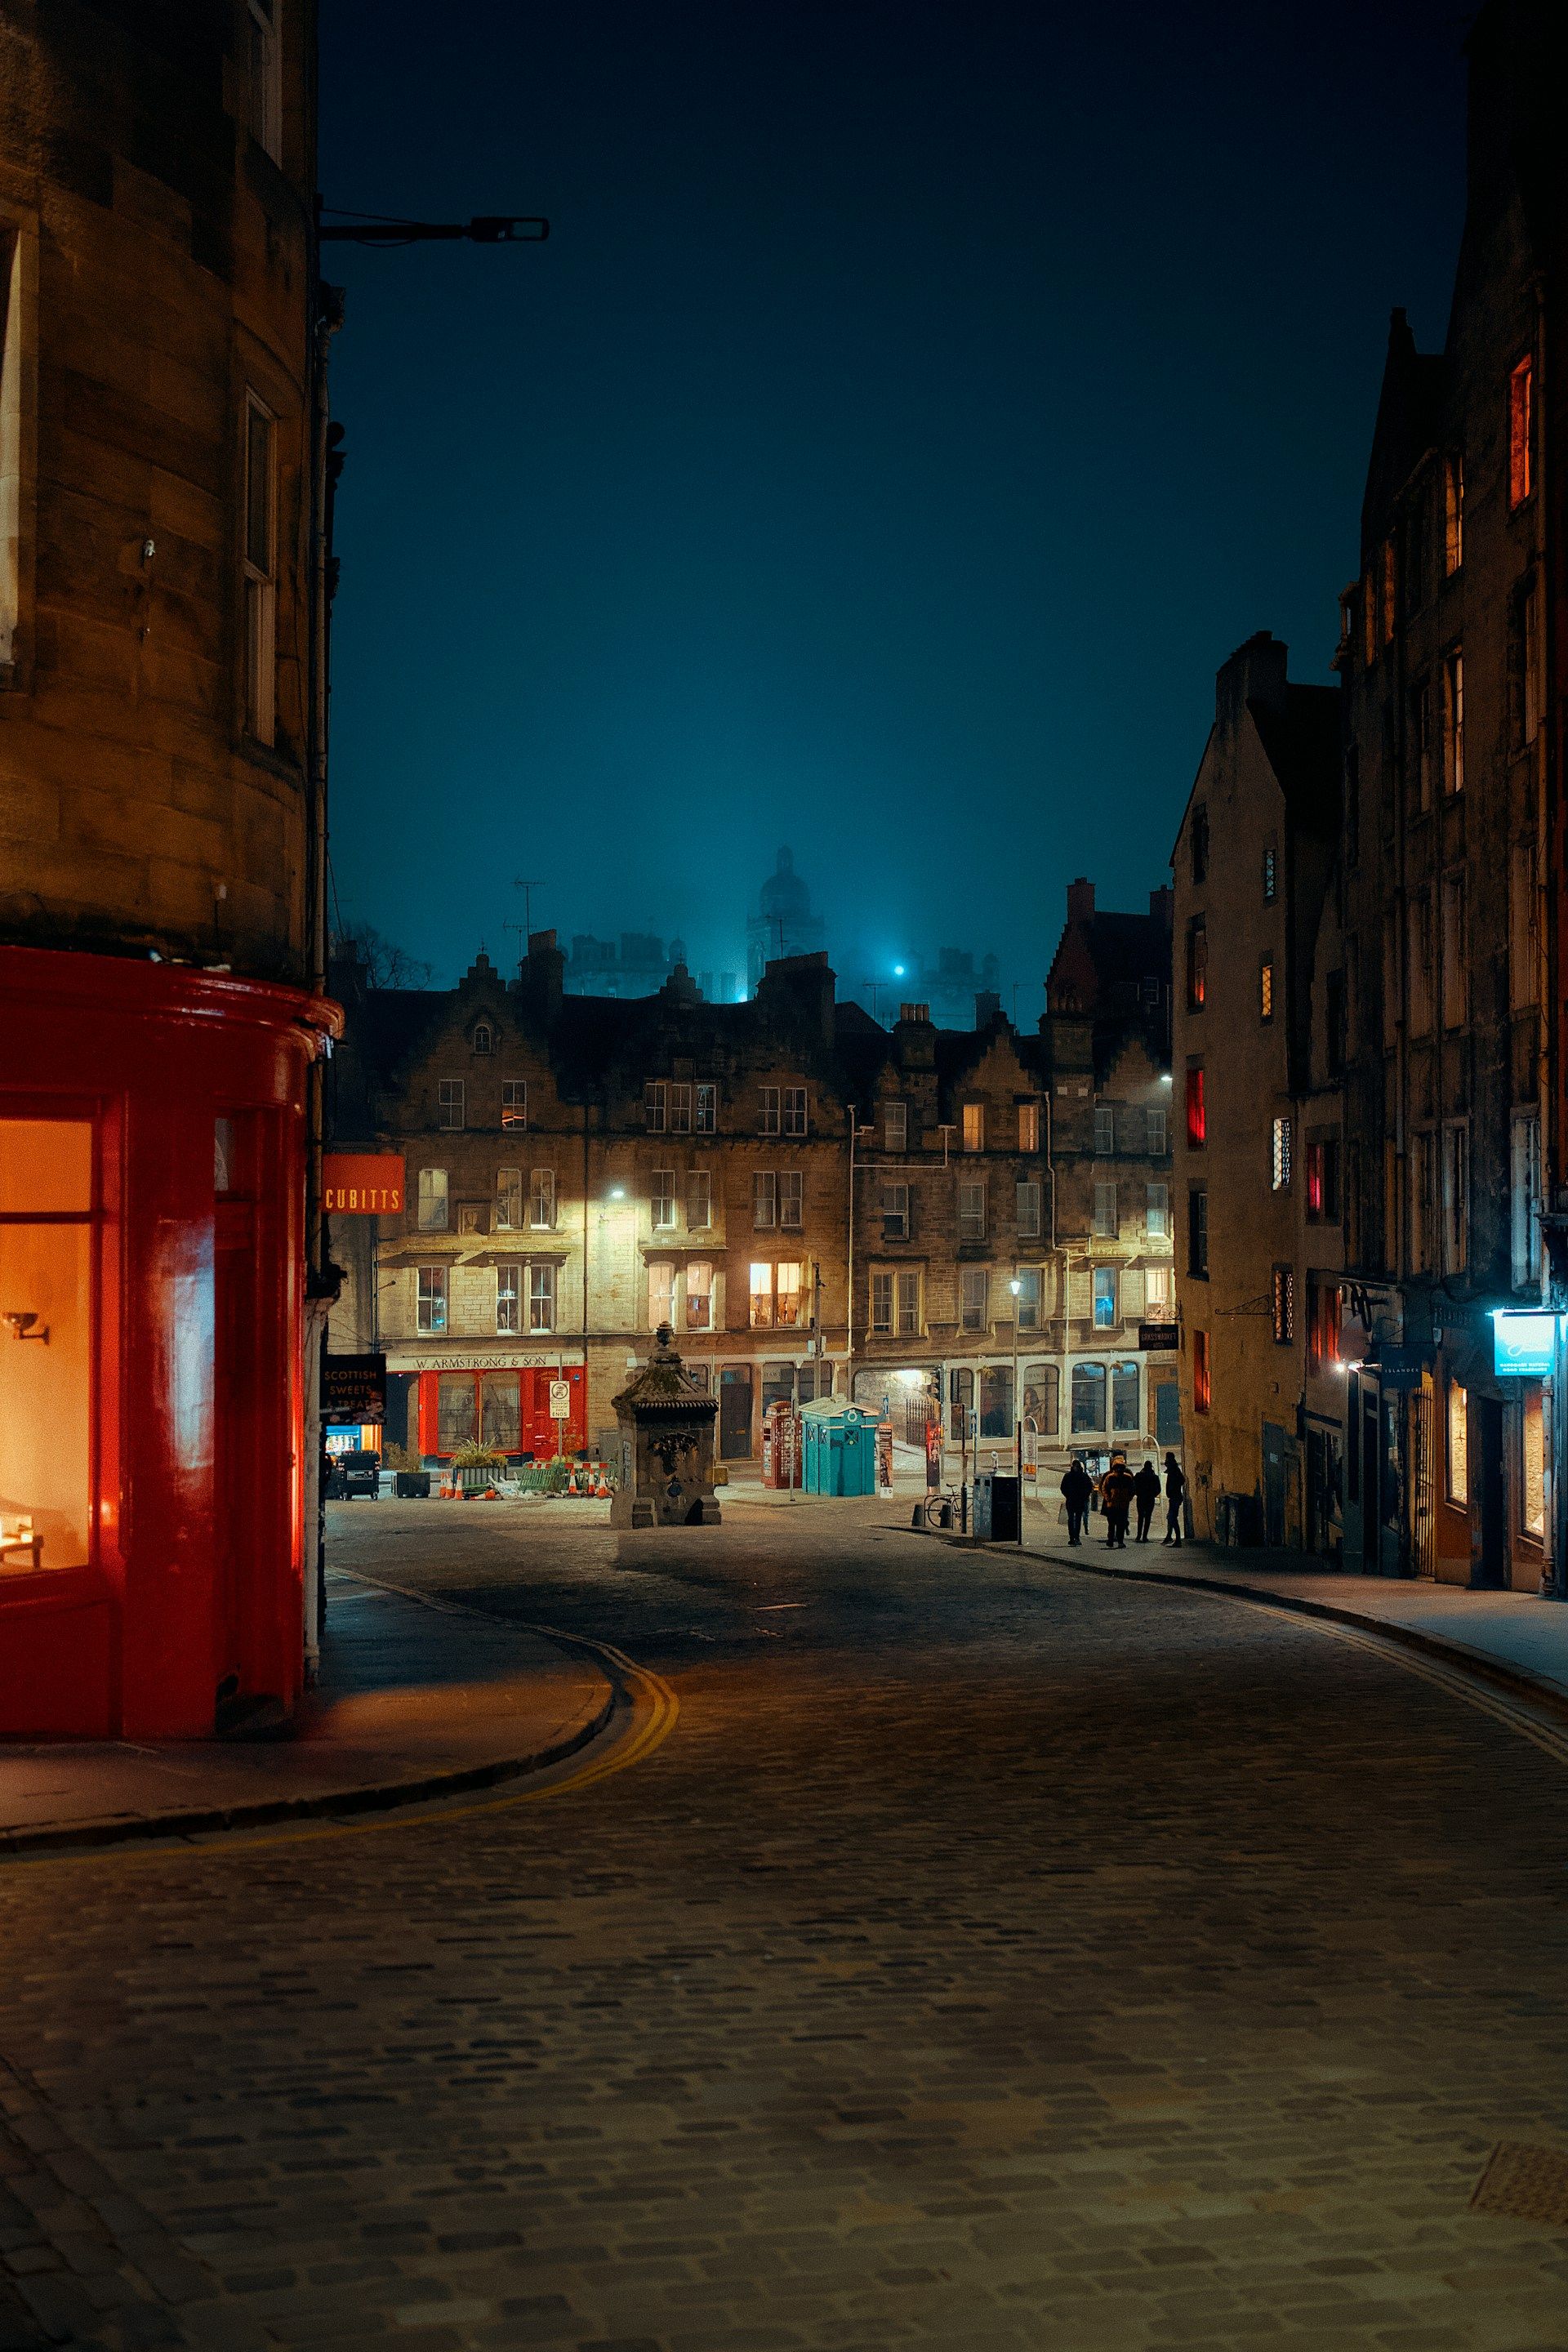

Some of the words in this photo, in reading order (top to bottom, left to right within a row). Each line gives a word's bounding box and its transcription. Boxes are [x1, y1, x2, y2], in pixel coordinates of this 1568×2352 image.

[325, 1188, 399, 1209] CUBITTS
[416, 1359, 430, 1369] W.
[432, 1356, 507, 1369] ARMSTRONG
[510, 1357, 519, 1366] &
[523, 1355, 547, 1366] SON
[324, 1370, 377, 1381] SCOTTISH
[328, 1384, 372, 1396] SWEETS
